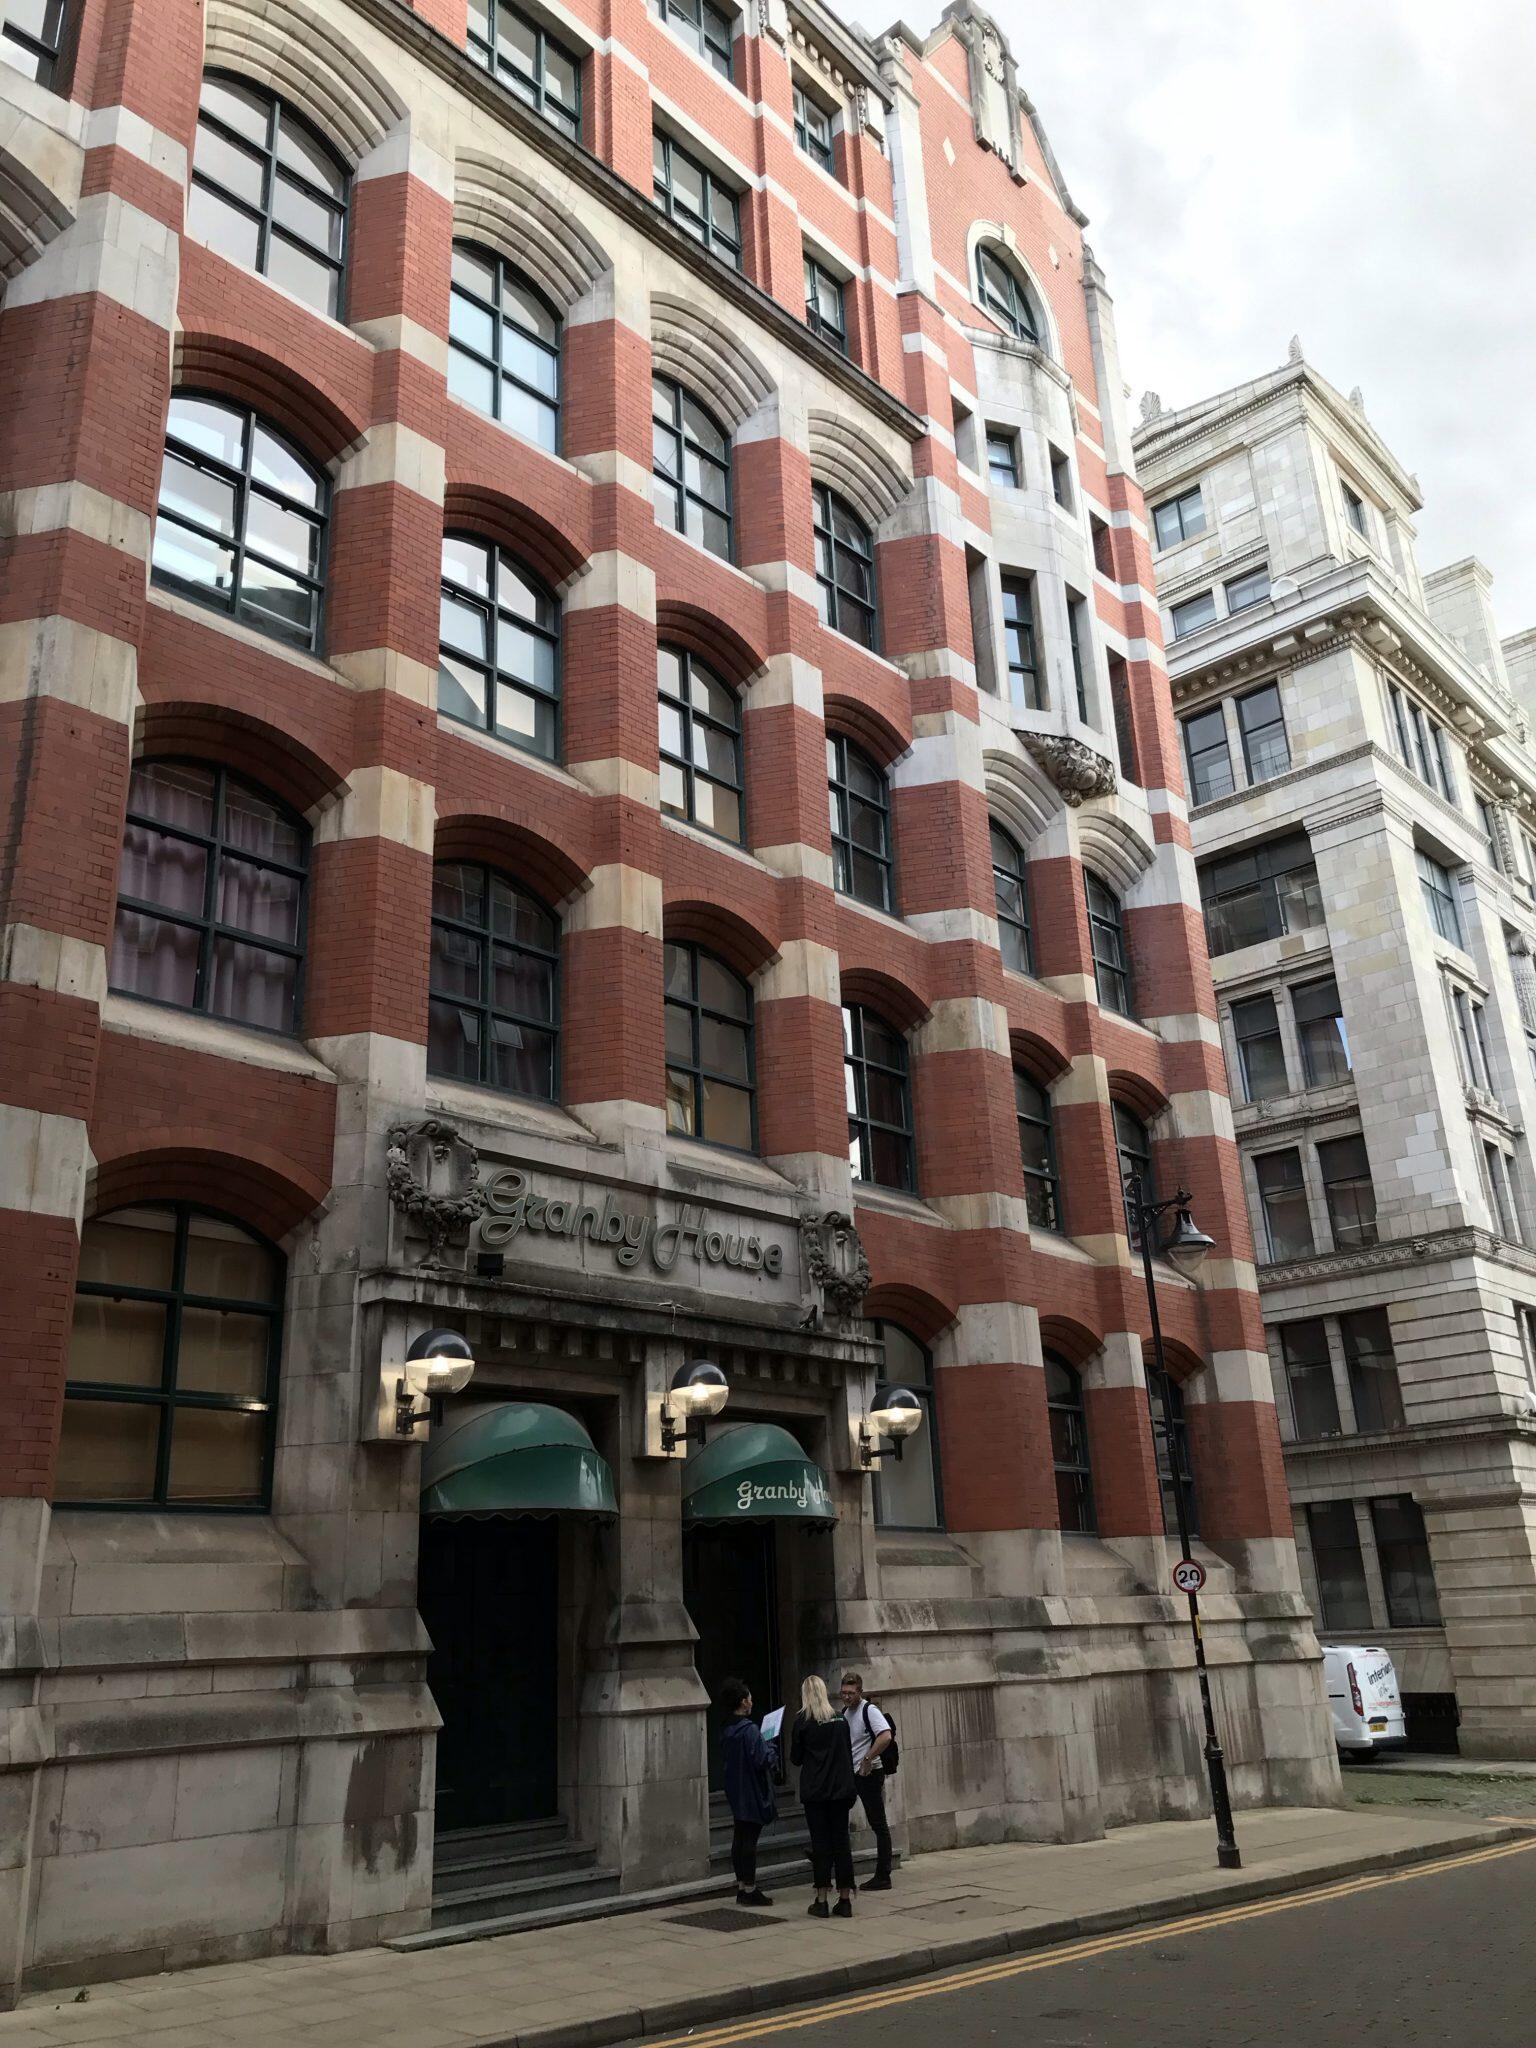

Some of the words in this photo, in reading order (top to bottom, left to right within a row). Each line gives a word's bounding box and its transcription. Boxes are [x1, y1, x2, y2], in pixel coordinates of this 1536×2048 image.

[481, 1167, 649, 1267] Granby
[652, 1203, 784, 1274] House
[736, 1480, 808, 1510] Granby
[1178, 1569, 1200, 1584] 20
